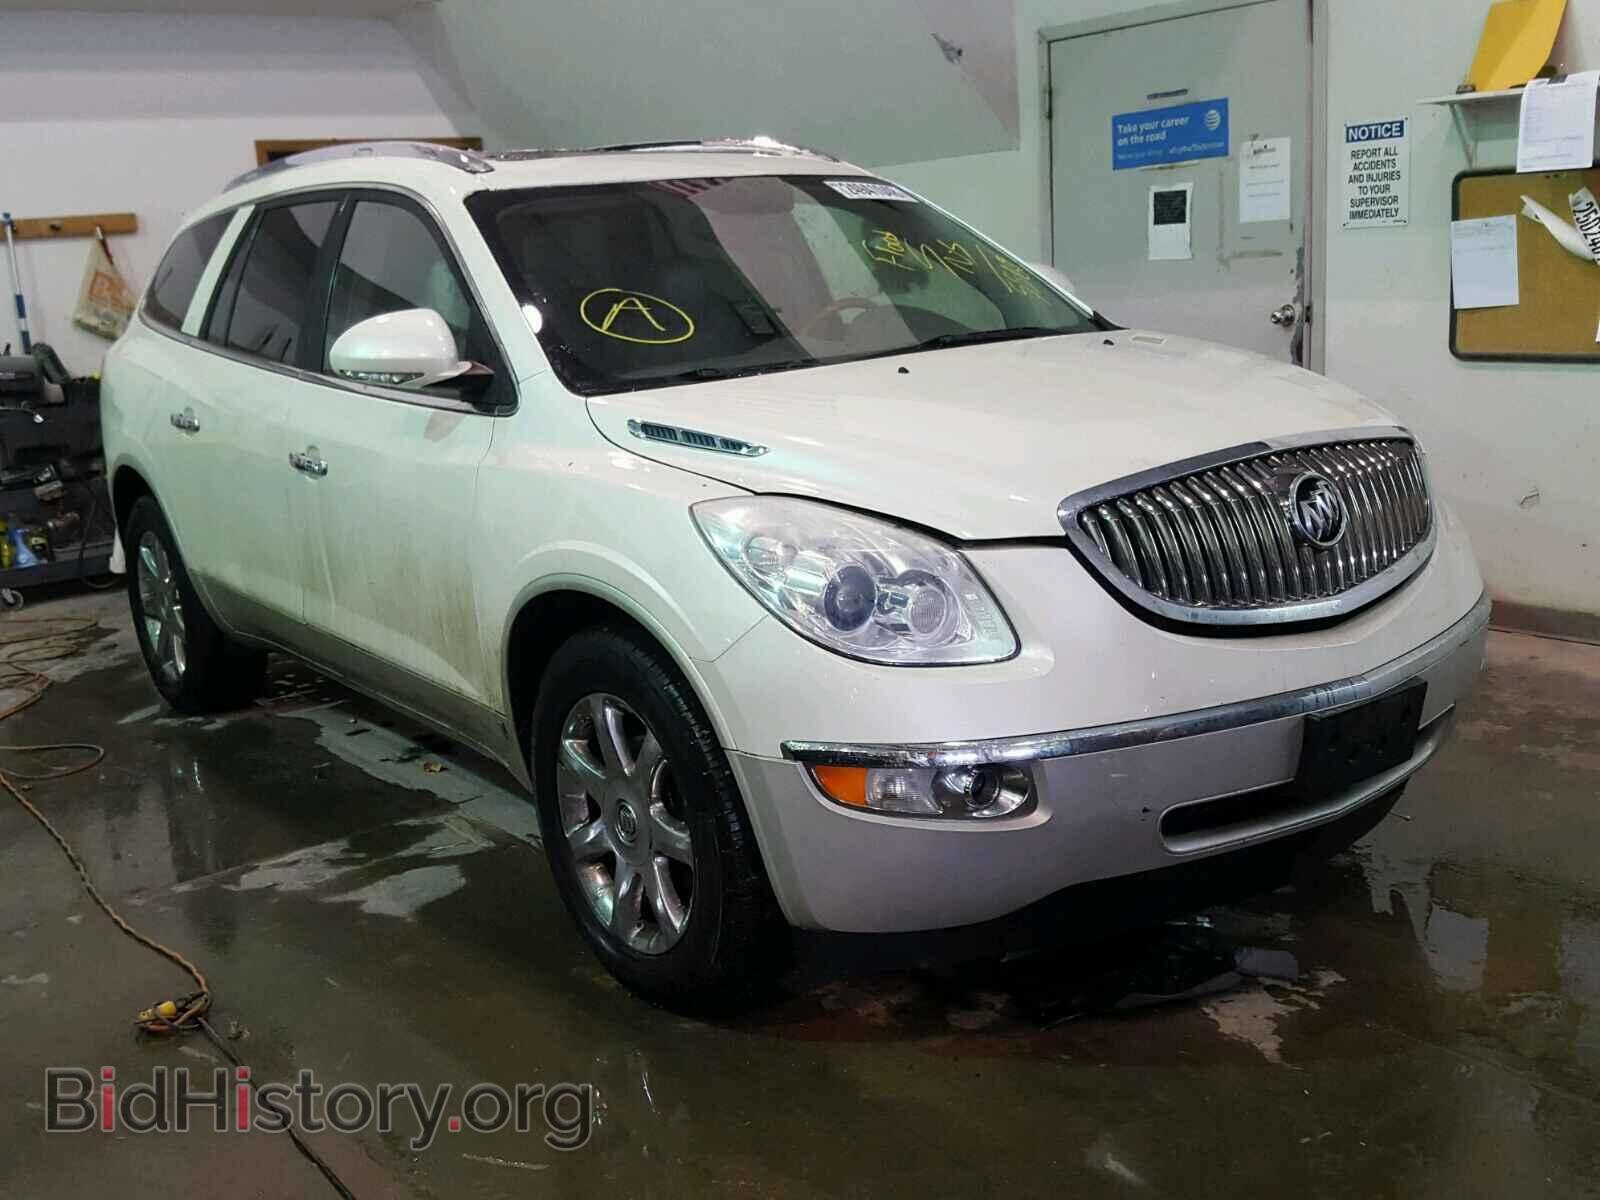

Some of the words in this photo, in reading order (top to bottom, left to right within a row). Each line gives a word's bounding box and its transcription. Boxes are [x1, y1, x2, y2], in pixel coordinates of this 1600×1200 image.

[1118, 123, 1138, 134] Take
[1140, 120, 1159, 133] your
[1161, 116, 1190, 128] career
[1130, 134, 1144, 144] the
[1146, 131, 1167, 143] road
[1347, 123, 1401, 141] NOTICE
[1350, 147, 1382, 160] REPORT
[1383, 146, 1398, 156] ALL
[1352, 158, 1397, 171] ACCIDENTS
[1348, 174, 1364, 184] AND
[1365, 171, 1401, 183] INJURIES
[1358, 185, 1368, 195] TO
[1369, 184, 1391, 195] YOUR
[1350, 195, 1399, 208] SUPERVISOR
[1349, 207, 1399, 220] IMMEDIATELY
[602, 297, 667, 332] A
